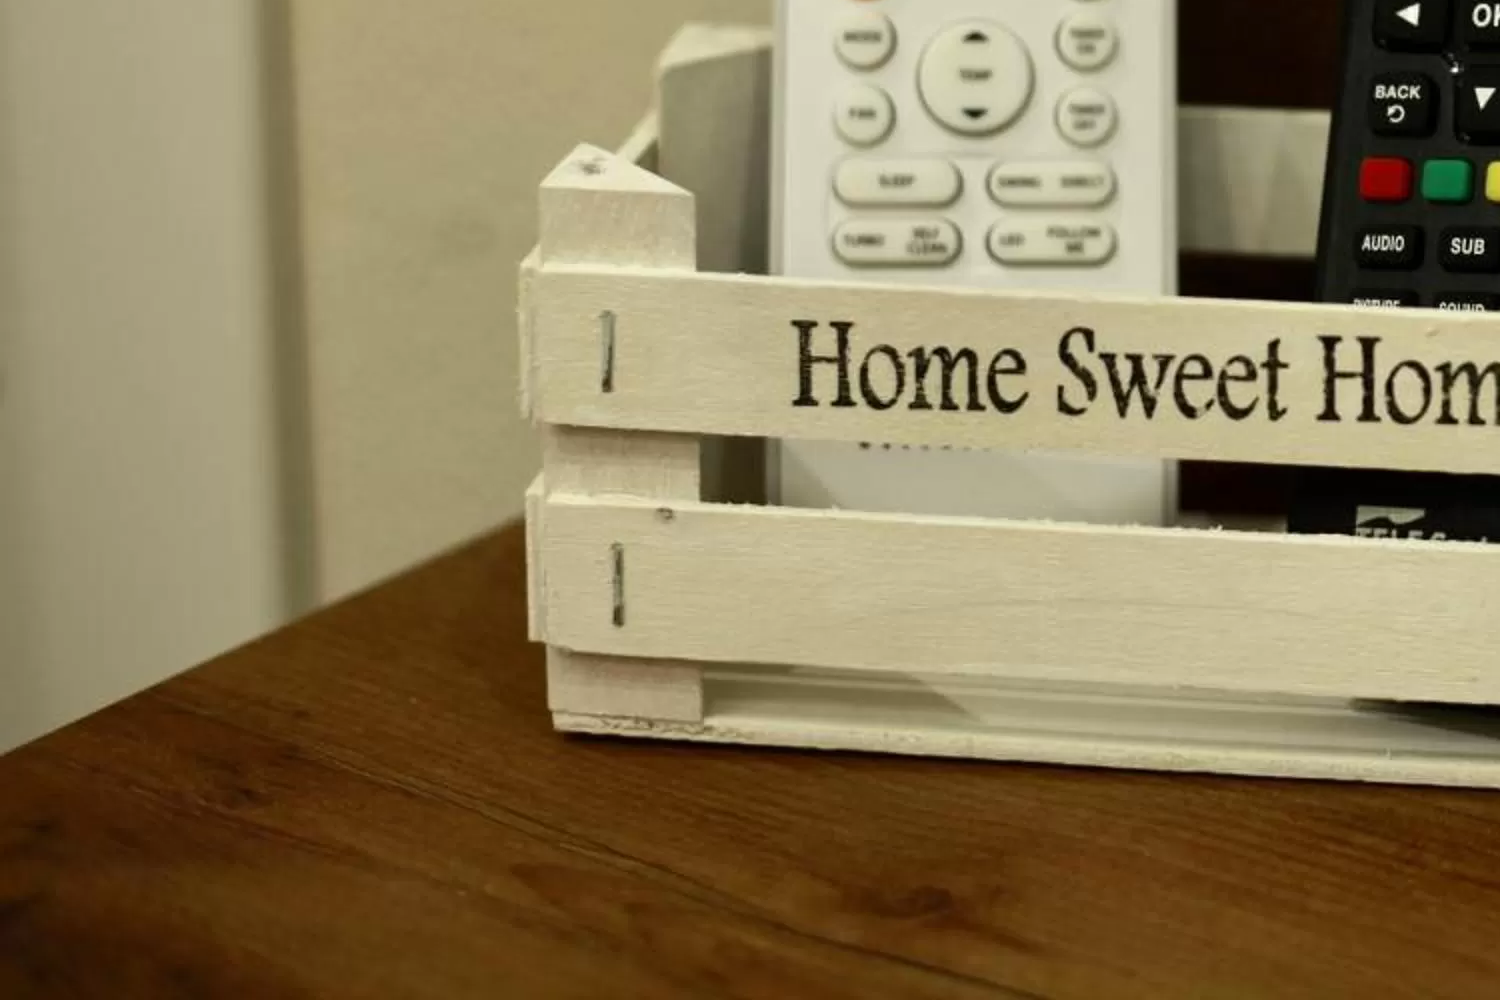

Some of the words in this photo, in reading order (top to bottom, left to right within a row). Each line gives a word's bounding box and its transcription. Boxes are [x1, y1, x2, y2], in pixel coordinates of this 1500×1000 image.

[1374, 84, 1421, 100] BACK
[1361, 234, 1405, 252] AUDIO
[1450, 236, 1485, 255] SUB
[790, 319, 1029, 415] Home
[1056, 326, 1289, 422] Sweet
